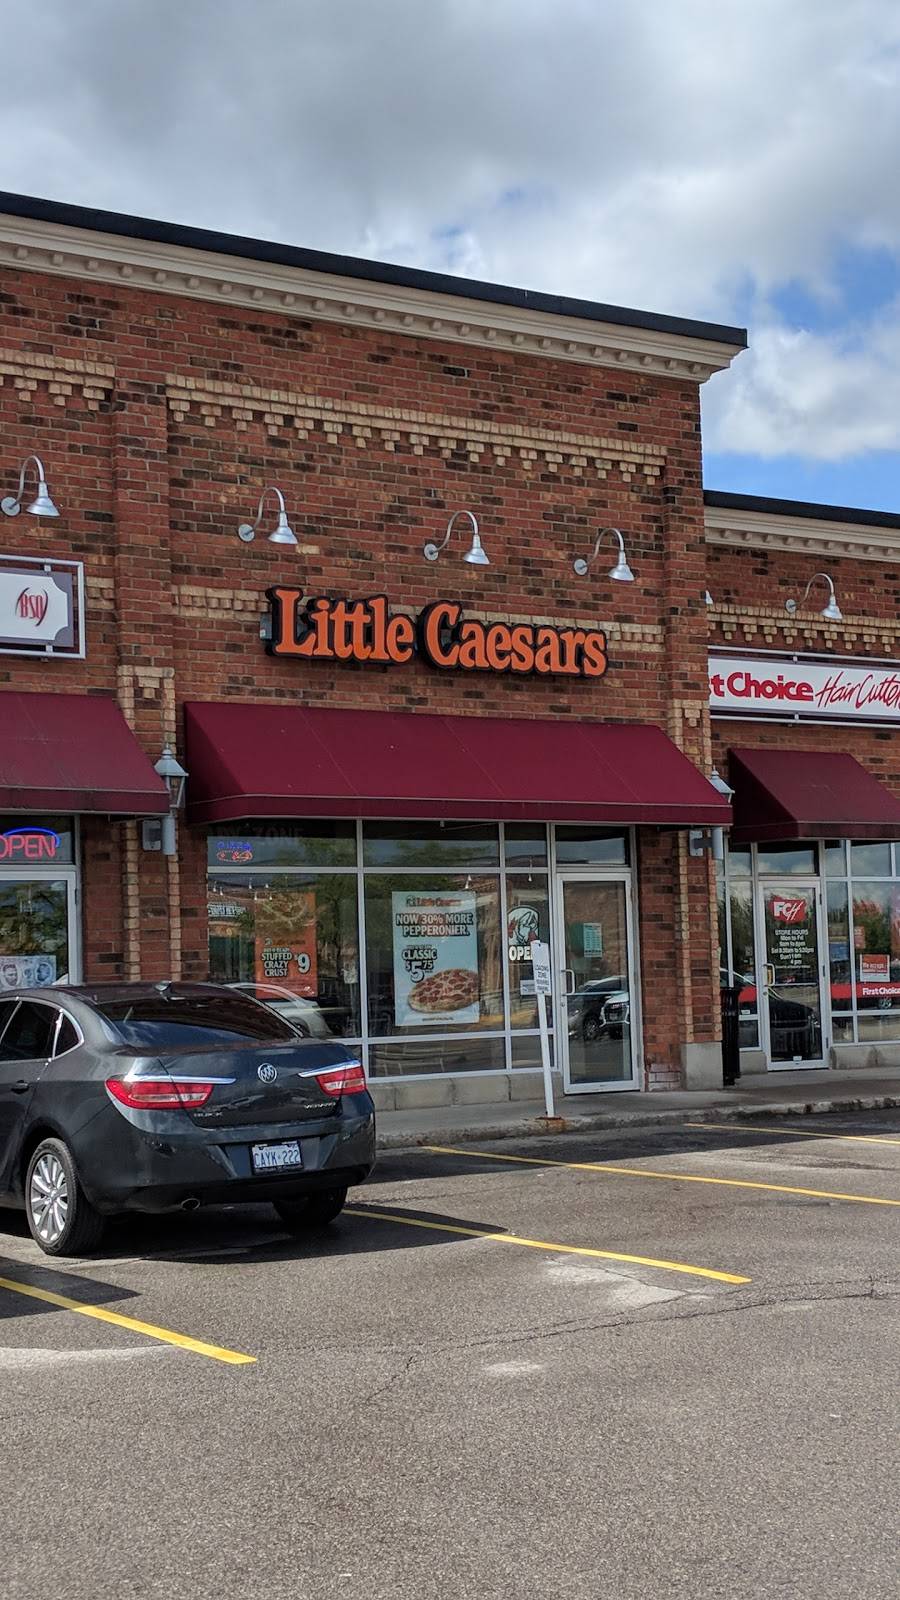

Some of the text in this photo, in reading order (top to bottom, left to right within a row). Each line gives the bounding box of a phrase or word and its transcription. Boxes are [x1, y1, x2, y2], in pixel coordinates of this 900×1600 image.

[274, 588, 608, 677] Little Caesars
[727, 672, 814, 702] Choice
[815, 671, 860, 708] Hair
[855, 674, 900, 709] Cutter
[396, 914, 474, 925] NOW 30% MORE
[403, 925, 471, 936] PEPPERONIER.
[261, 952, 293, 961] STUFFED
[402, 949, 438, 960] CLASSIC
[508, 945, 533, 961] OPE
[263, 960, 289, 969] CRAZY
[264, 968, 289, 977] CRUST
[862, 987, 879, 995] First
[253, 1149, 300, 1167] CAYK 222
